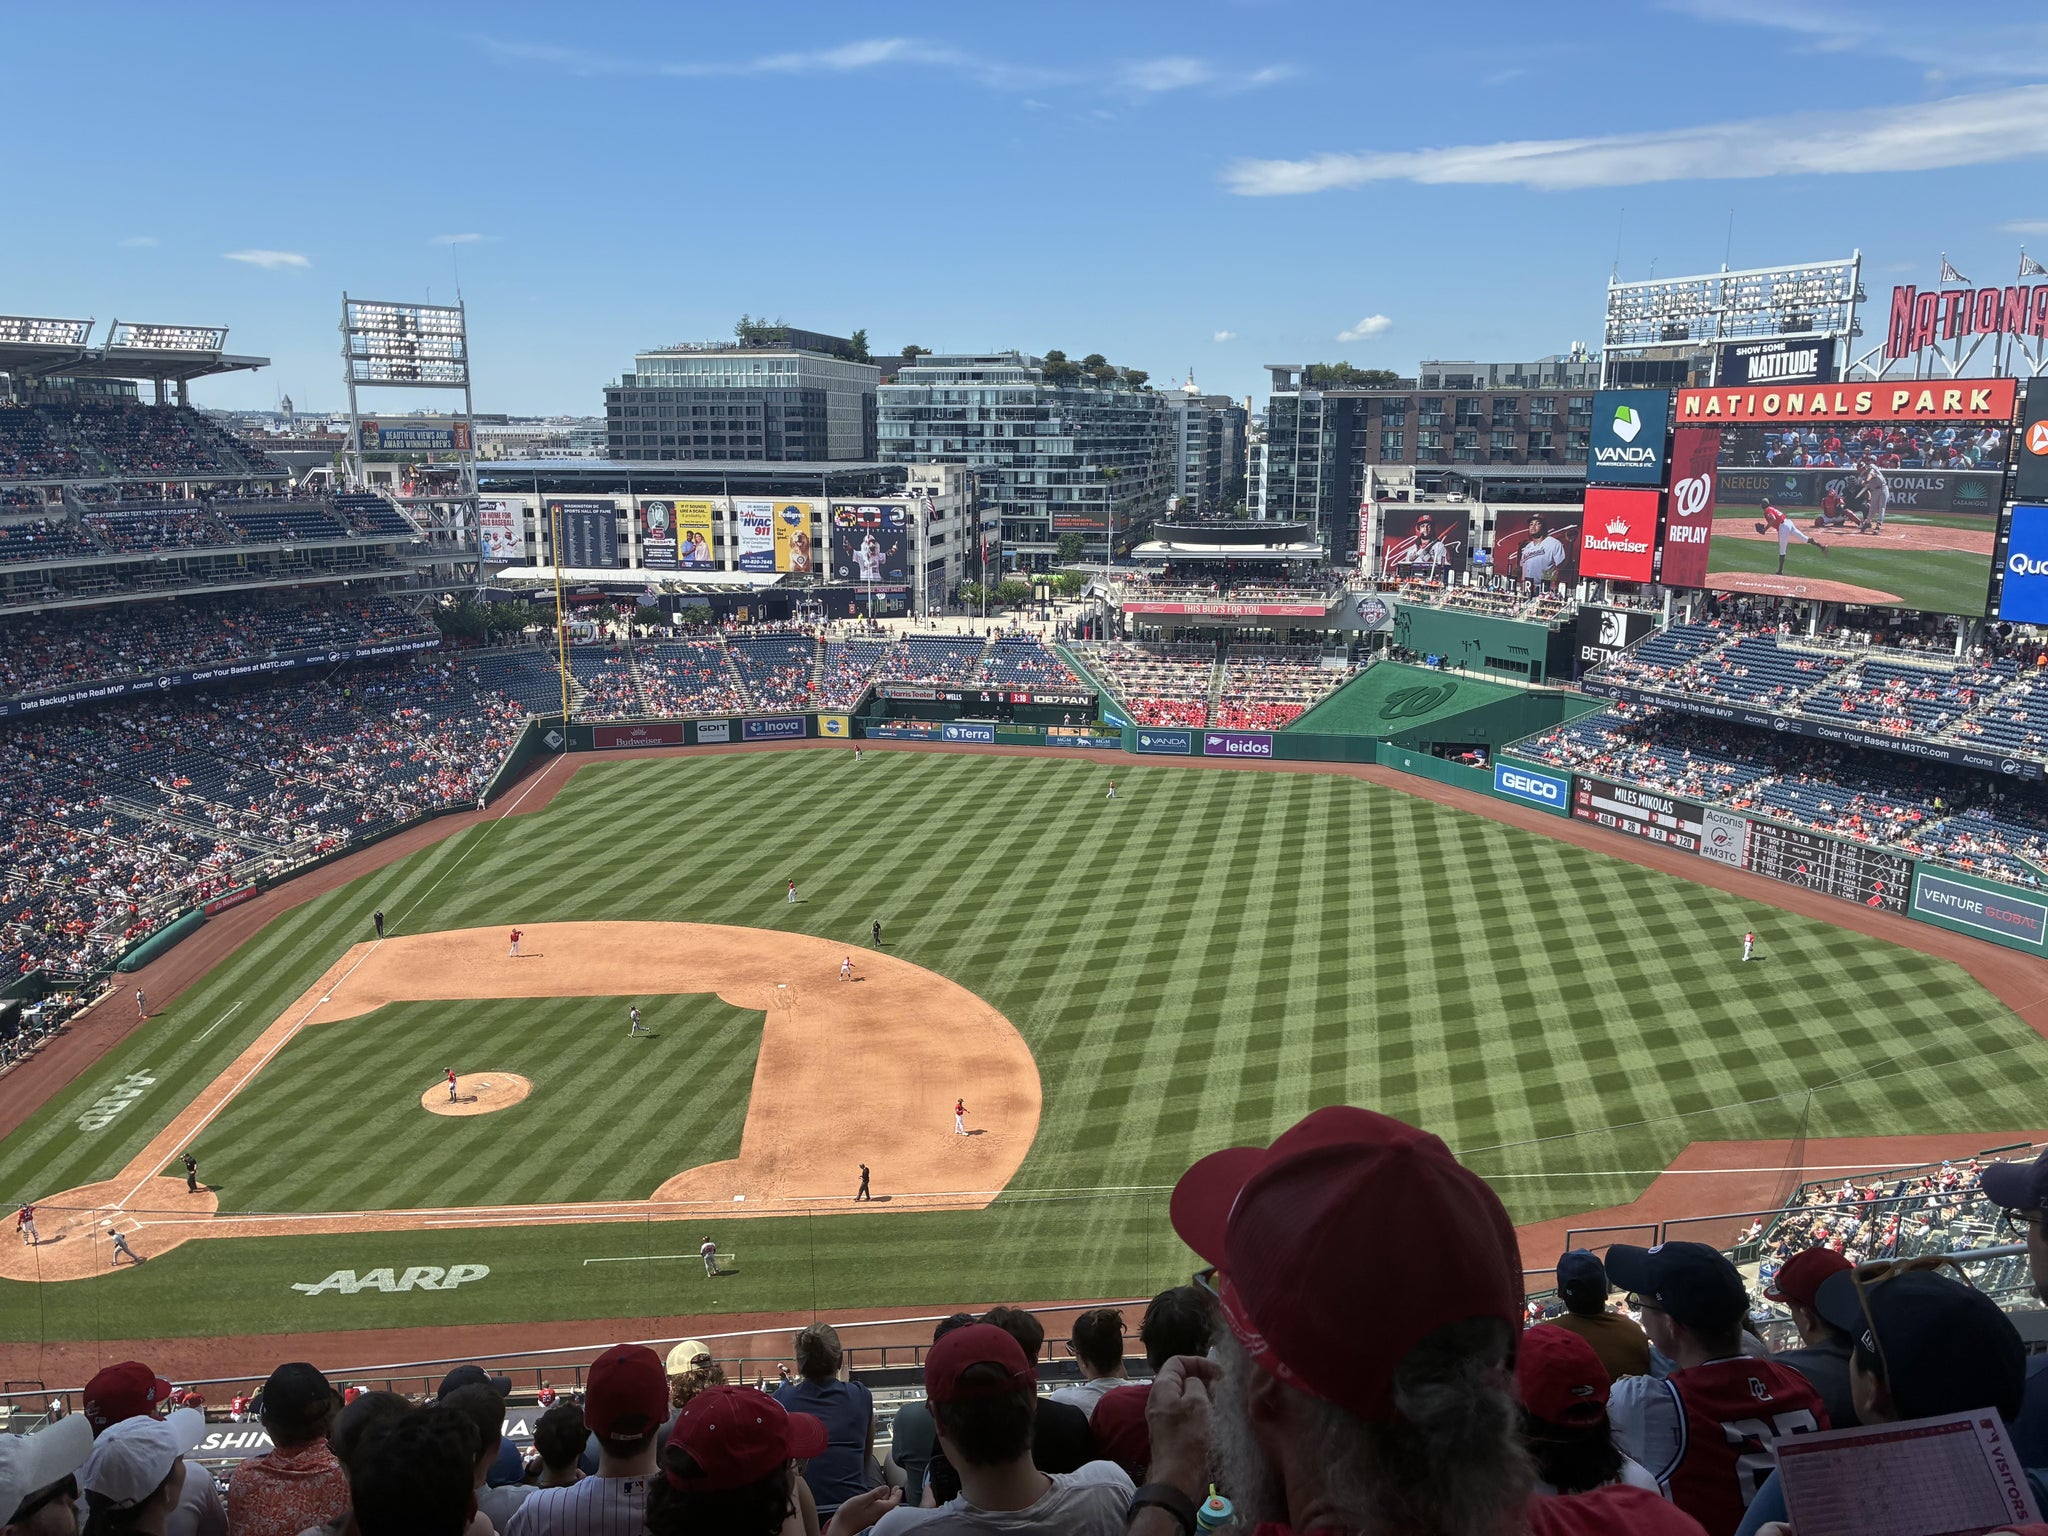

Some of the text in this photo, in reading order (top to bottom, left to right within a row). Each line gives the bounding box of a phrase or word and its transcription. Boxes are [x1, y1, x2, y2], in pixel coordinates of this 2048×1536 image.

[1736, 343, 1786, 356] SHOW SOME
[1747, 349, 1818, 378] NATITUDE
[1685, 389, 1991, 415] NATIONALS PARK
[386, 432, 416, 440] BEAUTIFUL
[384, 440, 404, 448] AWARD
[406, 440, 430, 448] WINNING
[1594, 448, 1656, 461] VANDA
[1721, 476, 1769, 489] NEREUS
[755, 527, 770, 535] 911
[1669, 525, 1708, 544] REPLAY
[1584, 535, 1648, 553] Budweiser
[1184, 604, 1262, 614] THIS BUD'S FOR YOU.
[371, 646, 395, 655] Backup
[192, 671, 213, 680] Cover
[213, 668, 230, 676] Your
[230, 664, 252, 674] Bases
[260, 659, 295, 670] M3TC.com
[20, 702, 38, 711] Data
[39, 695, 68, 707] Backup
[68, 693, 76, 702] Is
[76, 690, 88, 700] the
[89, 688, 106, 699] Real
[106, 685, 125, 695] MVP
[1014, 694, 1026, 702] 3:18
[1062, 696, 1088, 704] FAN
[1639, 694, 1655, 704] Data
[1655, 696, 1680, 709] Backup
[1680, 701, 1688, 710] Is
[1688, 702, 1700, 712] the
[1700, 705, 1716, 715] Real
[1716, 707, 1734, 718] MVP
[1744, 714, 1768, 725] Acronis
[765, 722, 798, 731] Inova
[959, 728, 990, 740] Terra
[616, 737, 662, 746] Budweiser
[1226, 740, 1269, 753] leidos
[1818, 727, 1950, 759] Cover Your Bases at M3TC.com
[1962, 754, 1993, 767] Acronis
[1502, 772, 1557, 799] GEICO
[1614, 787, 1674, 814] MILES MIKOLAS
[1628, 822, 1636, 831] 26
[1706, 811, 1743, 829] Acronis
[1654, 829, 1662, 839] 1-3
[1763, 826, 1776, 836] MIA
[1800, 835, 1809, 844] TB
[1679, 836, 1692, 847] 7.20
[1703, 846, 1736, 862] #M3TC
[1792, 848, 1812, 856] DELAYED
[1842, 891, 1855, 899] CWS
[1924, 888, 2037, 929] VENTURE GLOBAL
[75, 1068, 157, 1131] AARP
[290, 1264, 490, 1296] AARP
[1992, 1446, 2029, 1520] VISITORS
